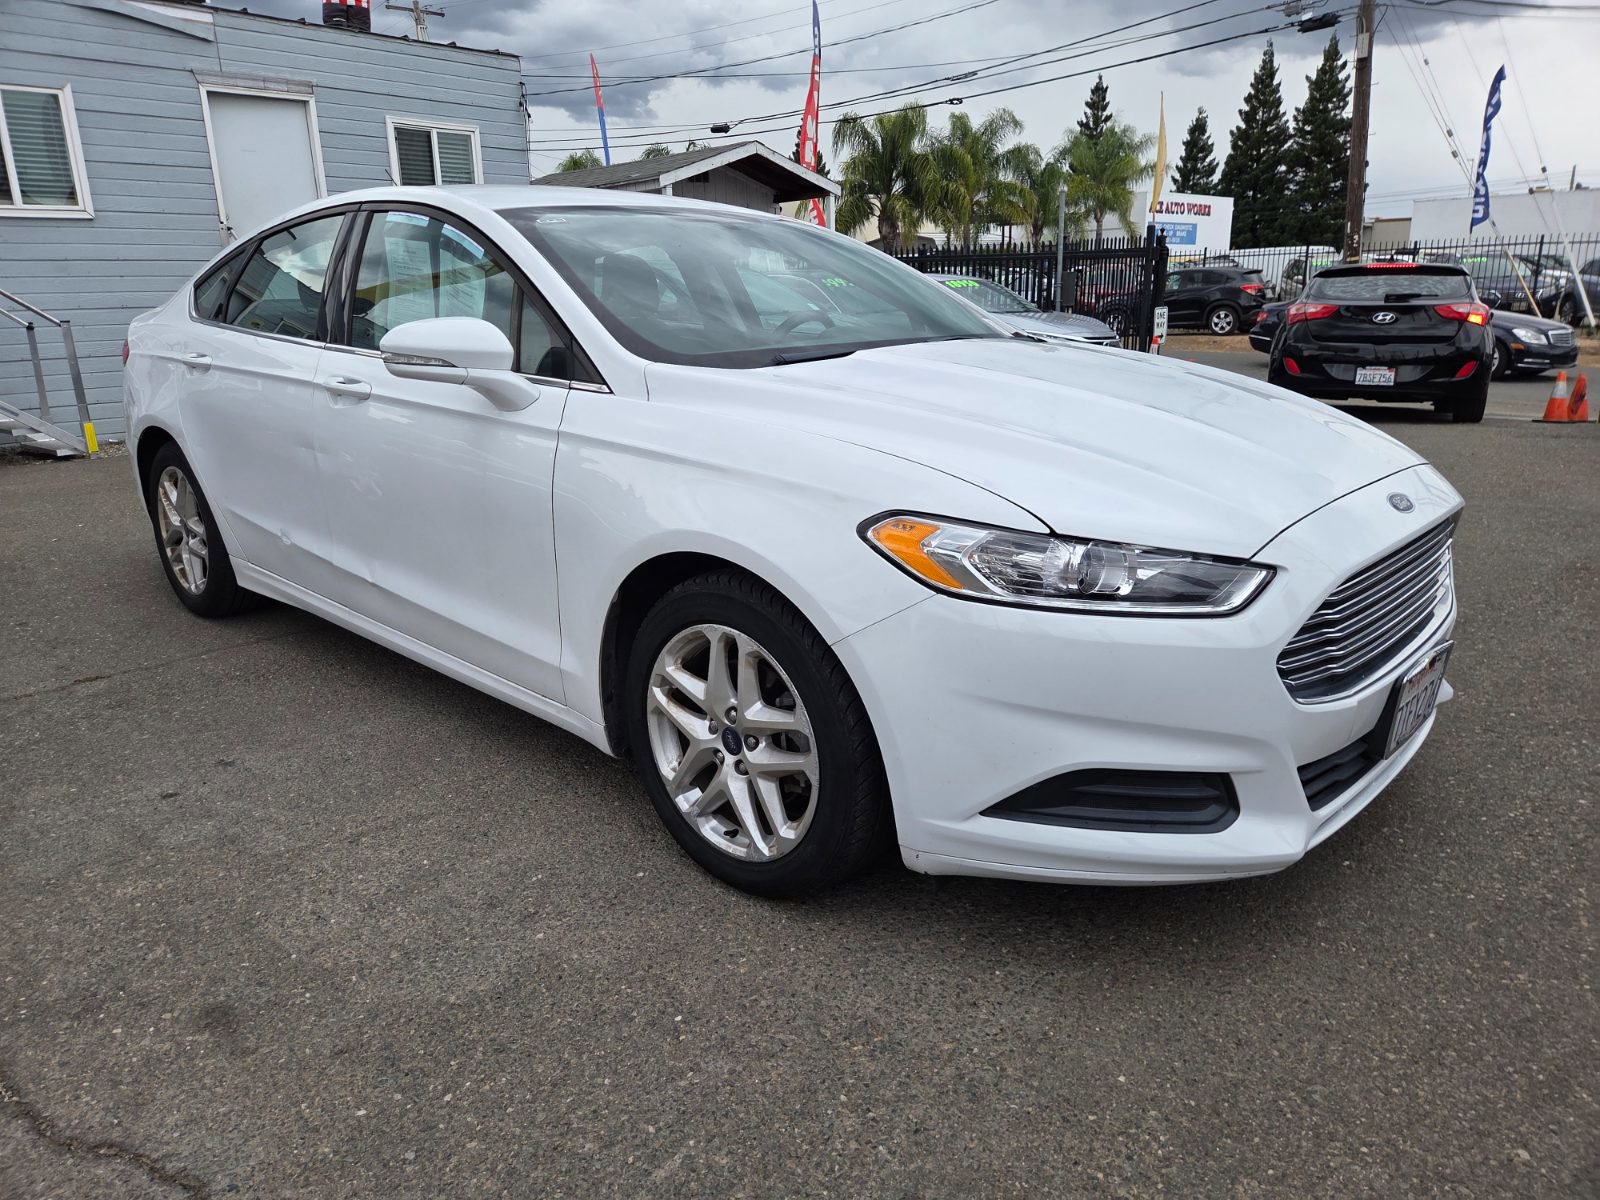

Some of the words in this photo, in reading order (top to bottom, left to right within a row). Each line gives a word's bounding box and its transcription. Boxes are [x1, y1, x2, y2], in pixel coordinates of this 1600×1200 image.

[1164, 202, 1185, 214] AUTO
[1186, 202, 1211, 216] WORKS
[1156, 311, 1166, 320] ONE
[1155, 321, 1166, 329] WAY
